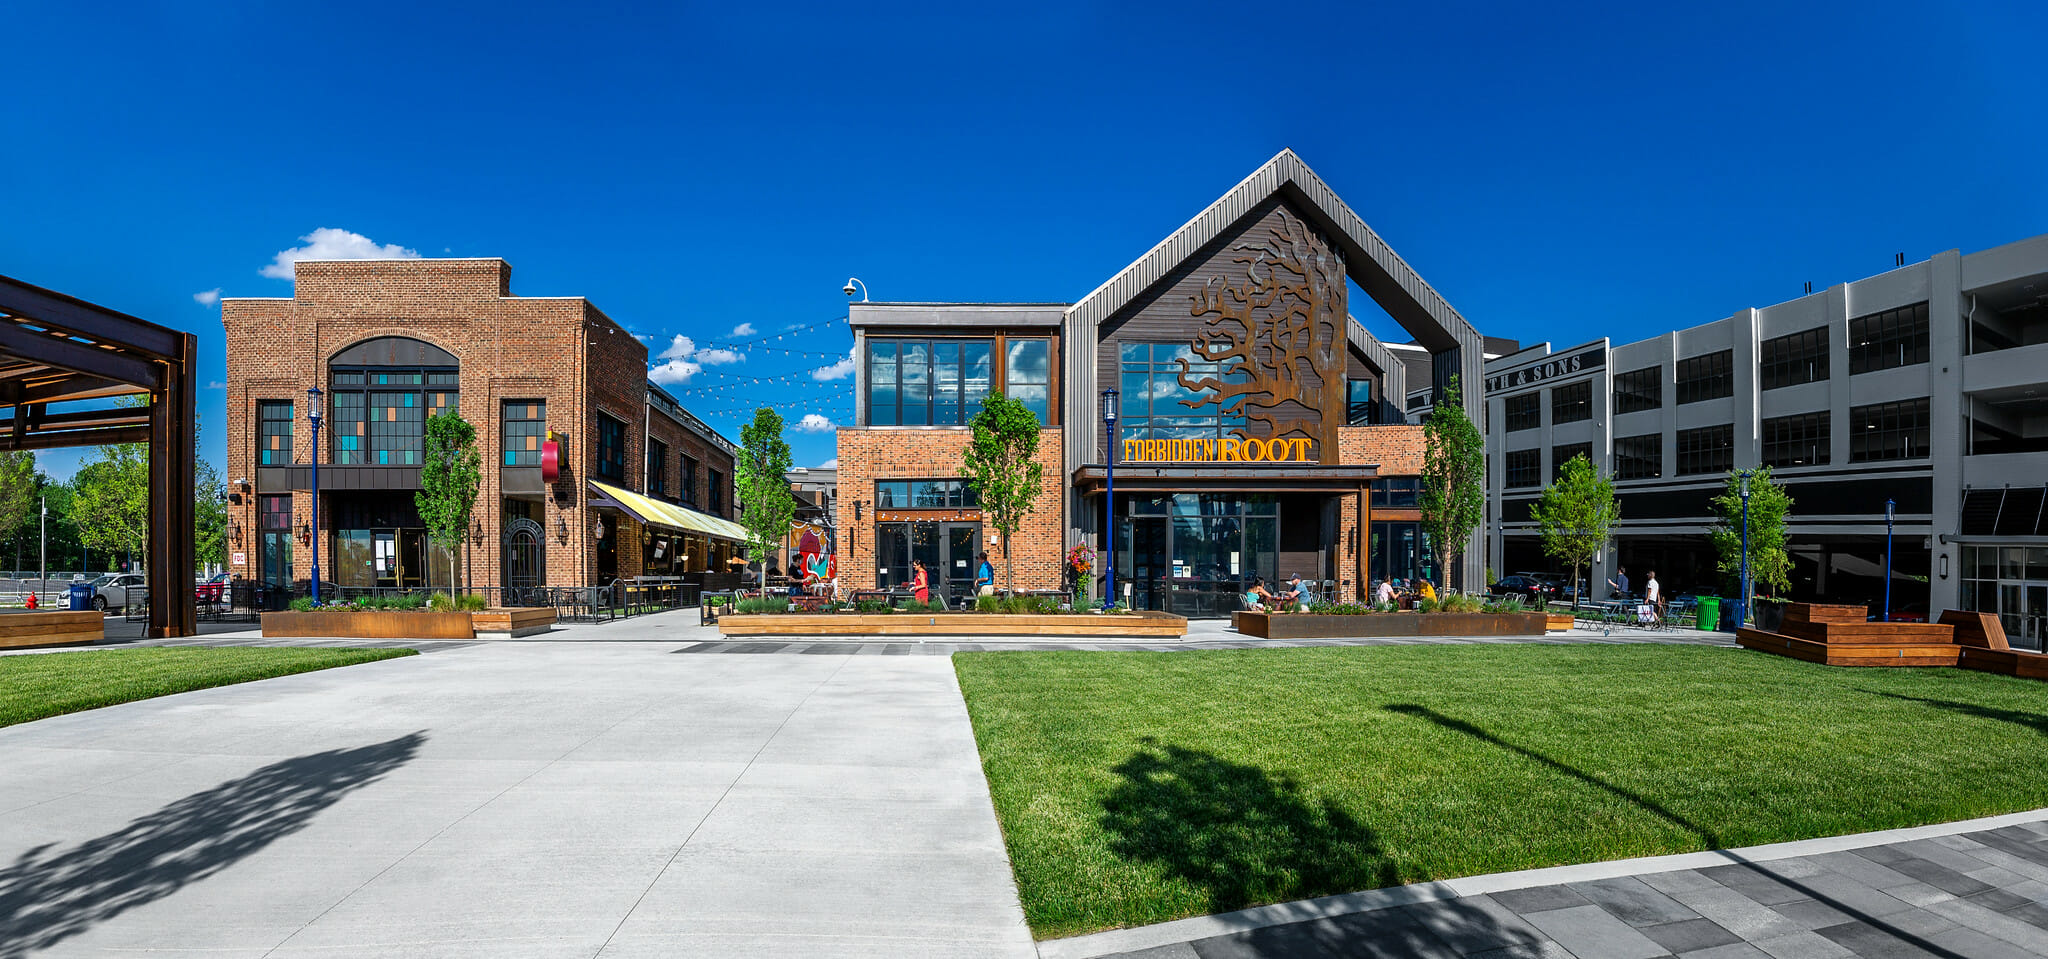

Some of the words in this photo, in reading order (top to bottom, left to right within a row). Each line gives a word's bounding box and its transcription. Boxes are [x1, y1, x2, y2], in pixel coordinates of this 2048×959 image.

[1485, 375, 1510, 392] TH
[1517, 371, 1526, 385] &
[1534, 356, 1581, 381] SONS
[1124, 439, 1214, 461] FORBIDDEN
[1216, 438, 1312, 461] ROOT
